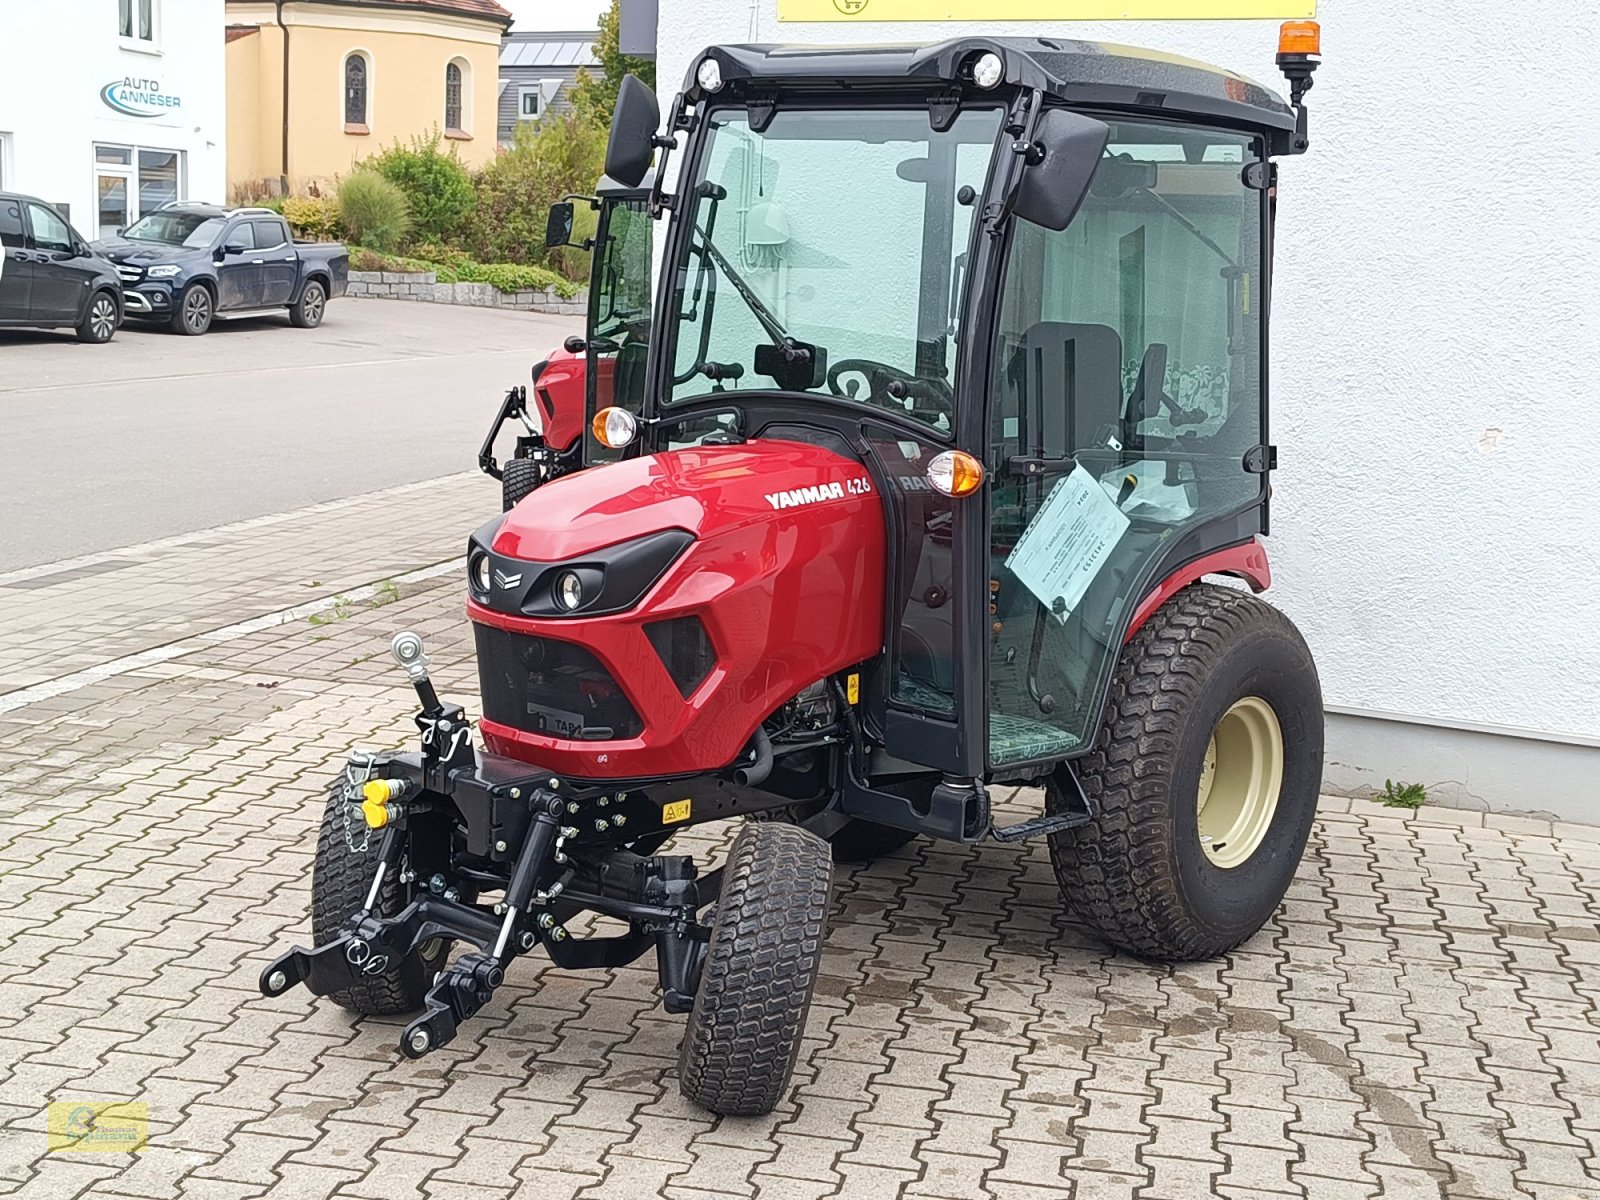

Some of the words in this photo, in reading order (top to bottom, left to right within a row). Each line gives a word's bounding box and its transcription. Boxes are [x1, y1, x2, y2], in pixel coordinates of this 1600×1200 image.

[123, 77, 159, 92] AUTO
[120, 90, 181, 108] ANNESER
[764, 482, 845, 510] YANMAR
[846, 477, 871, 496] 426
